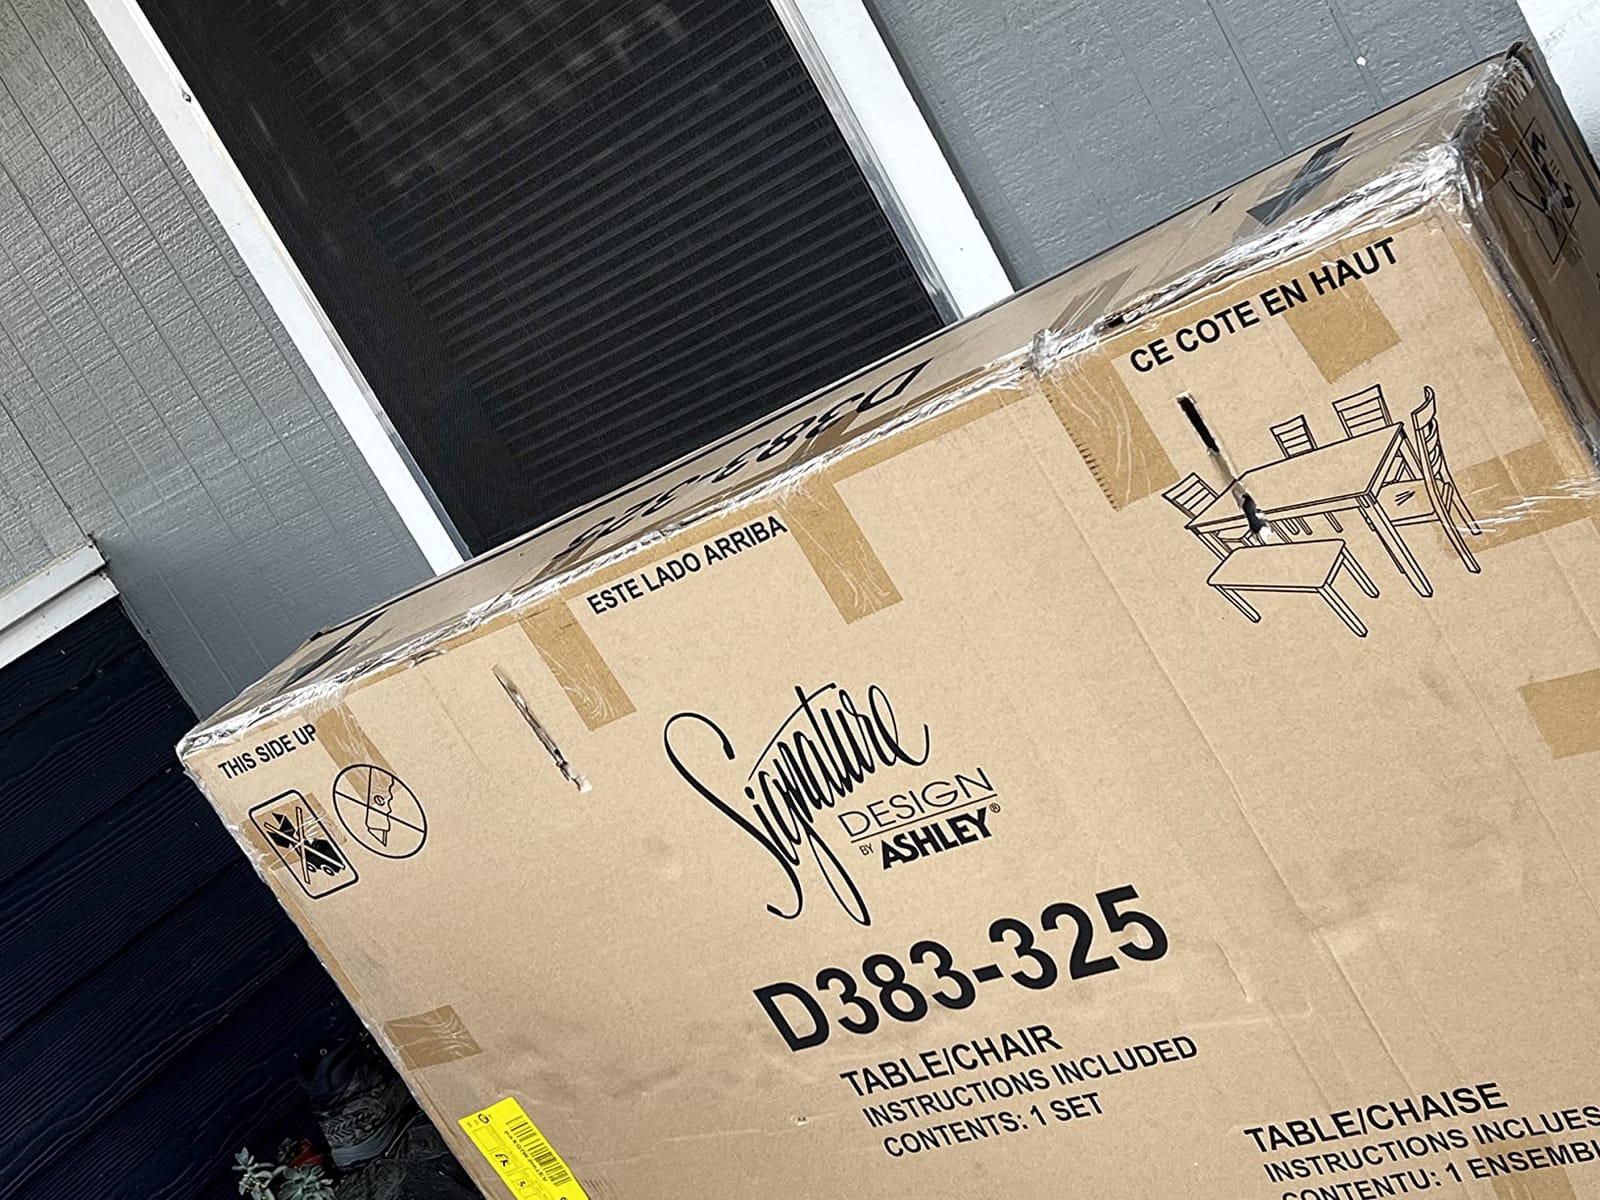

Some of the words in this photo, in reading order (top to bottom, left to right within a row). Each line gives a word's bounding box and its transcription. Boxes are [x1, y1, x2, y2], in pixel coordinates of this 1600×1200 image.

[1130, 338, 1175, 373] CE
[1175, 308, 1261, 352] COTE
[1259, 278, 1308, 317] EN
[1308, 236, 1397, 296] HAUT
[552, 357, 934, 563] D383-325
[586, 578, 645, 615] ESTE
[640, 552, 702, 593] LADO
[703, 516, 788, 566] ARRIBA
[217, 752, 257, 780] THIS
[255, 734, 297, 763] SIDE
[292, 723, 317, 746] UP
[664, 682, 930, 927] Signature
[837, 767, 994, 837] DESIGN
[859, 842, 875, 857] BY
[752, 884, 1168, 1052] D383-325
[839, 1024, 1063, 1097] TABLE/CHAIR
[862, 1068, 1051, 1128] INSTRUCTIONS
[1050, 1036, 1198, 1086] INCLUDED
[883, 1111, 1029, 1157] CONTENTS:
[1030, 1105, 1047, 1126] 1
[1049, 1092, 1103, 1122] SET
[1243, 1082, 1509, 1153] TABLE/CHAISE
[1263, 1129, 1469, 1183] INSTRUCTIONS
[1471, 1106, 1600, 1145] INCLUES
[1445, 1162, 1463, 1183] 1
